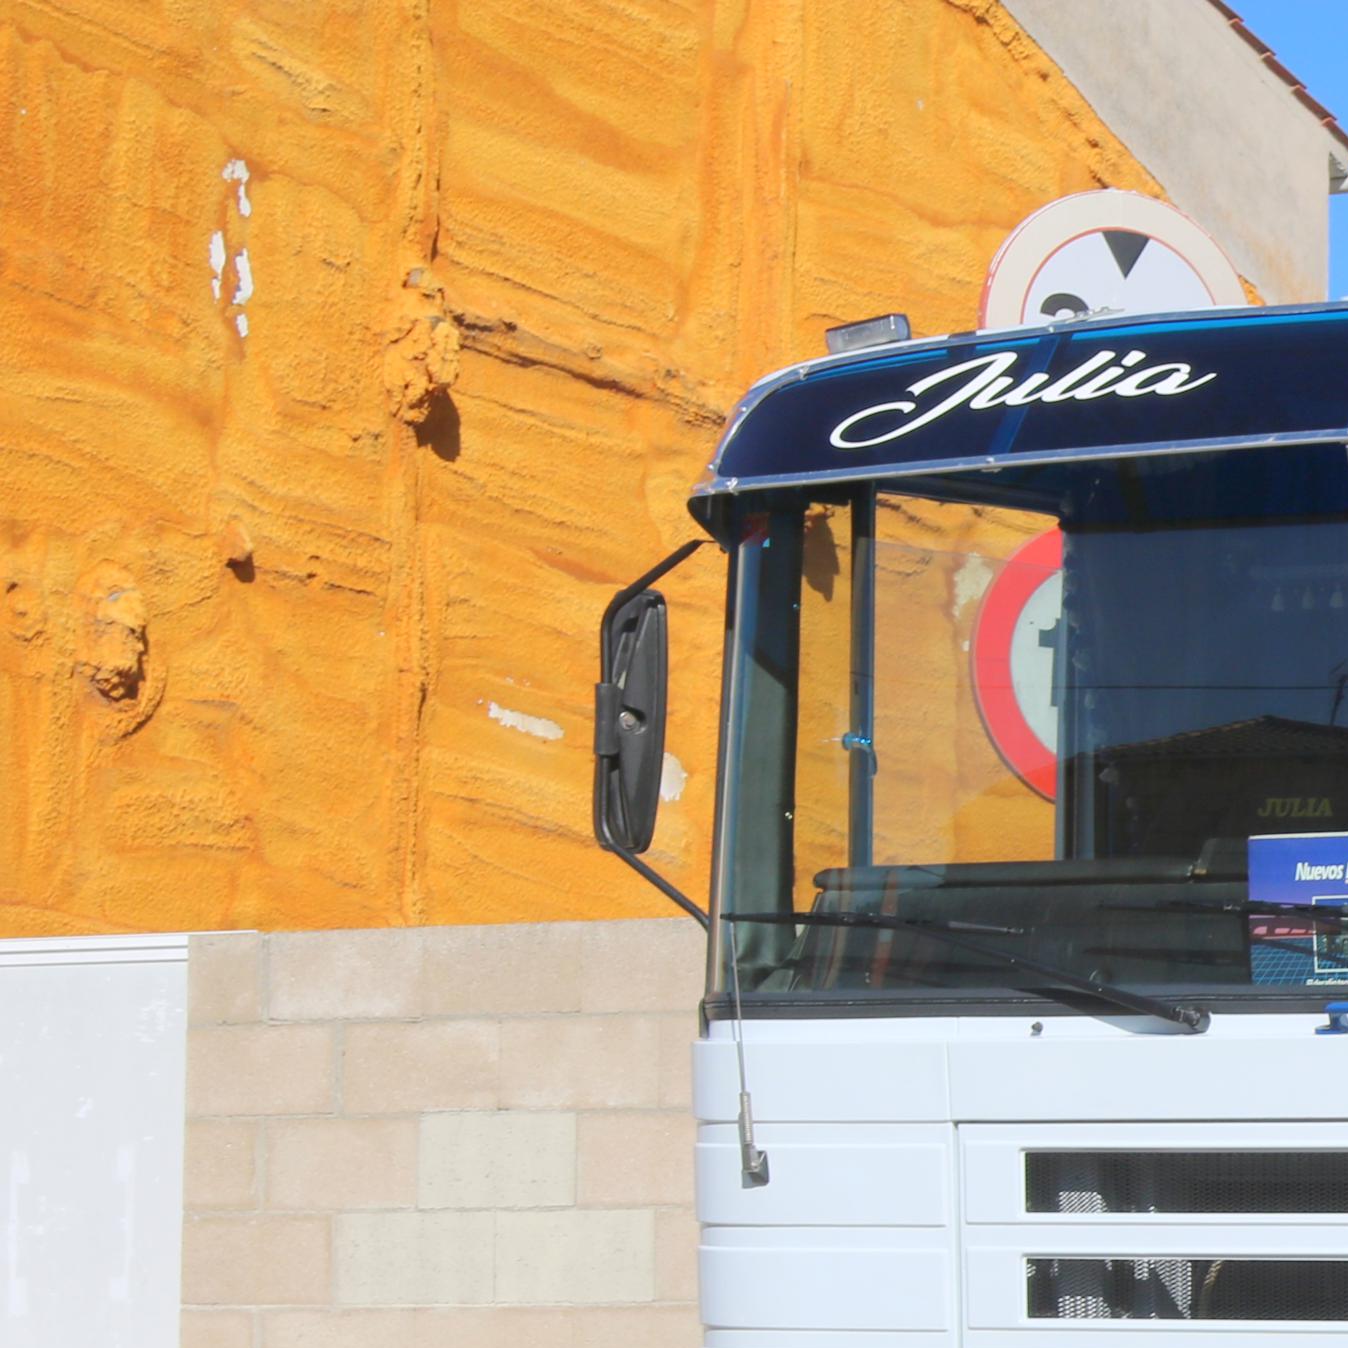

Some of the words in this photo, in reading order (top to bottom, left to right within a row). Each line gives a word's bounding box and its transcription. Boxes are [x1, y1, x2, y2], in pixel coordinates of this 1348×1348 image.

[828, 348, 1219, 452] Julia
[1258, 797, 1332, 817] JULIA
[1295, 861, 1344, 881] Nuevos
